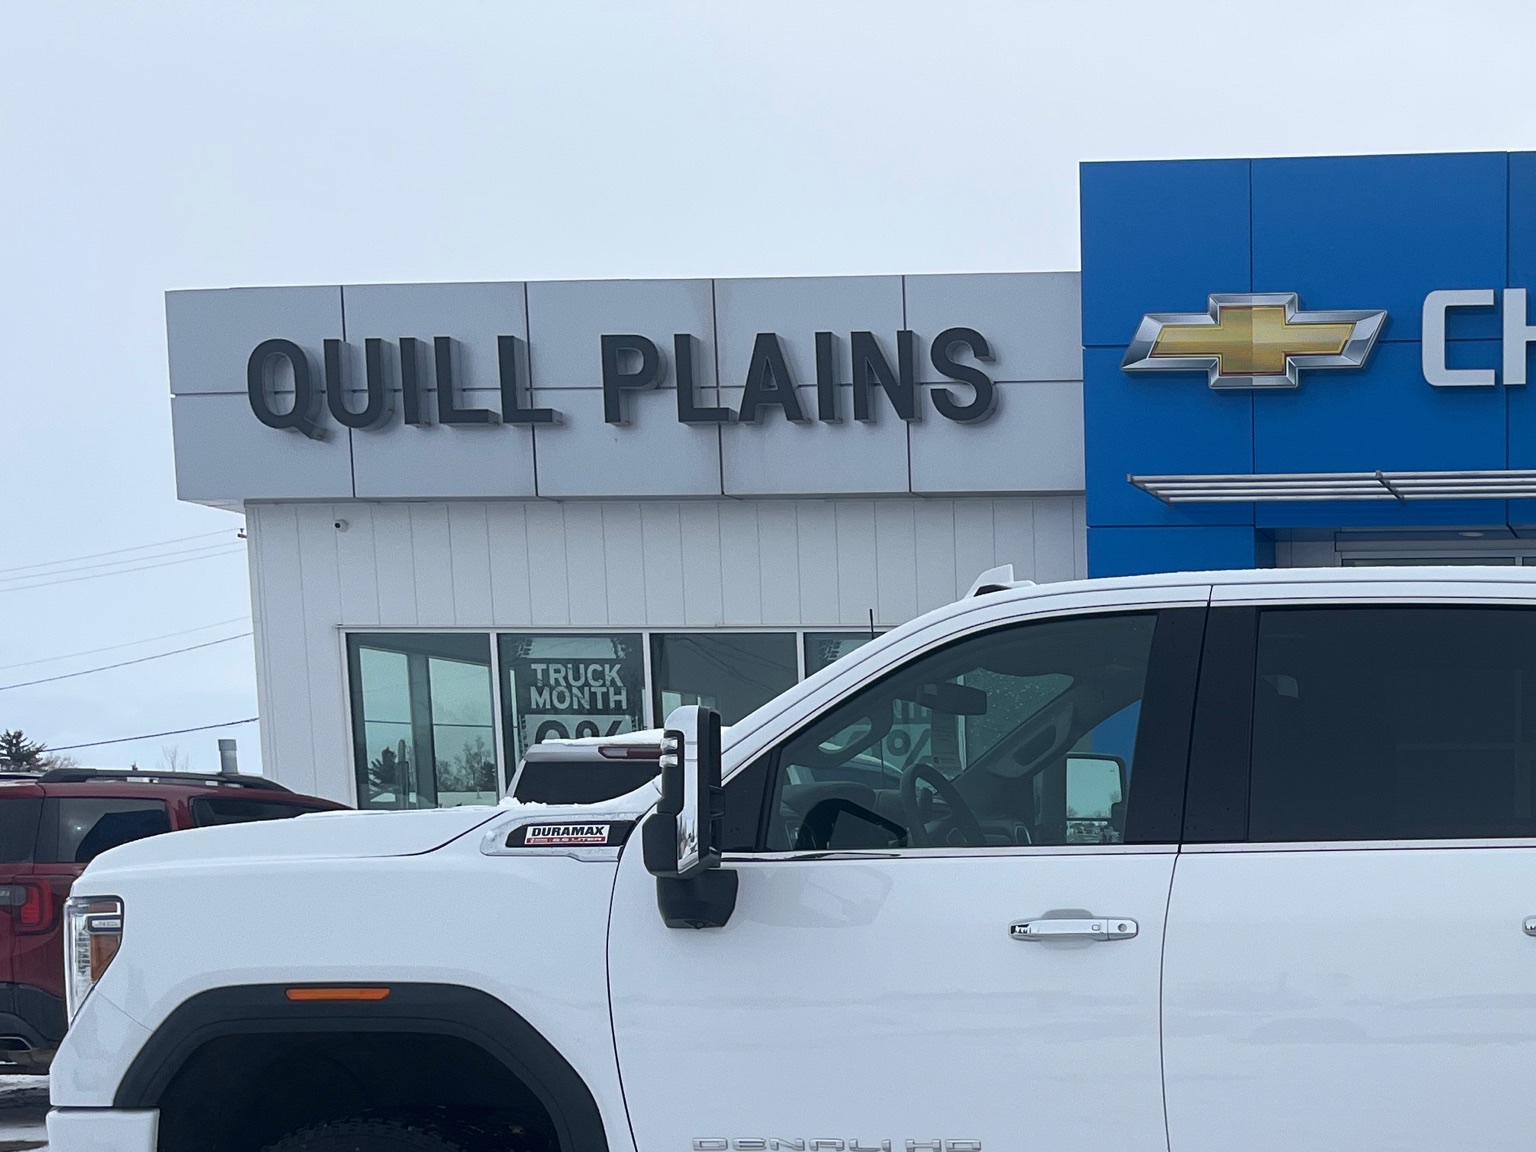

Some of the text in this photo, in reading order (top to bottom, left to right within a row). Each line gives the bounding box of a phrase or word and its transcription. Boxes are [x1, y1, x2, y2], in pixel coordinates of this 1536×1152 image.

[246, 326, 998, 441] QUILL PLAINS
[530, 663, 624, 687] TRUCK
[529, 686, 628, 710] MONTH
[531, 826, 605, 837] DURAMAX
[692, 1137, 982, 1152] DENALI HD
